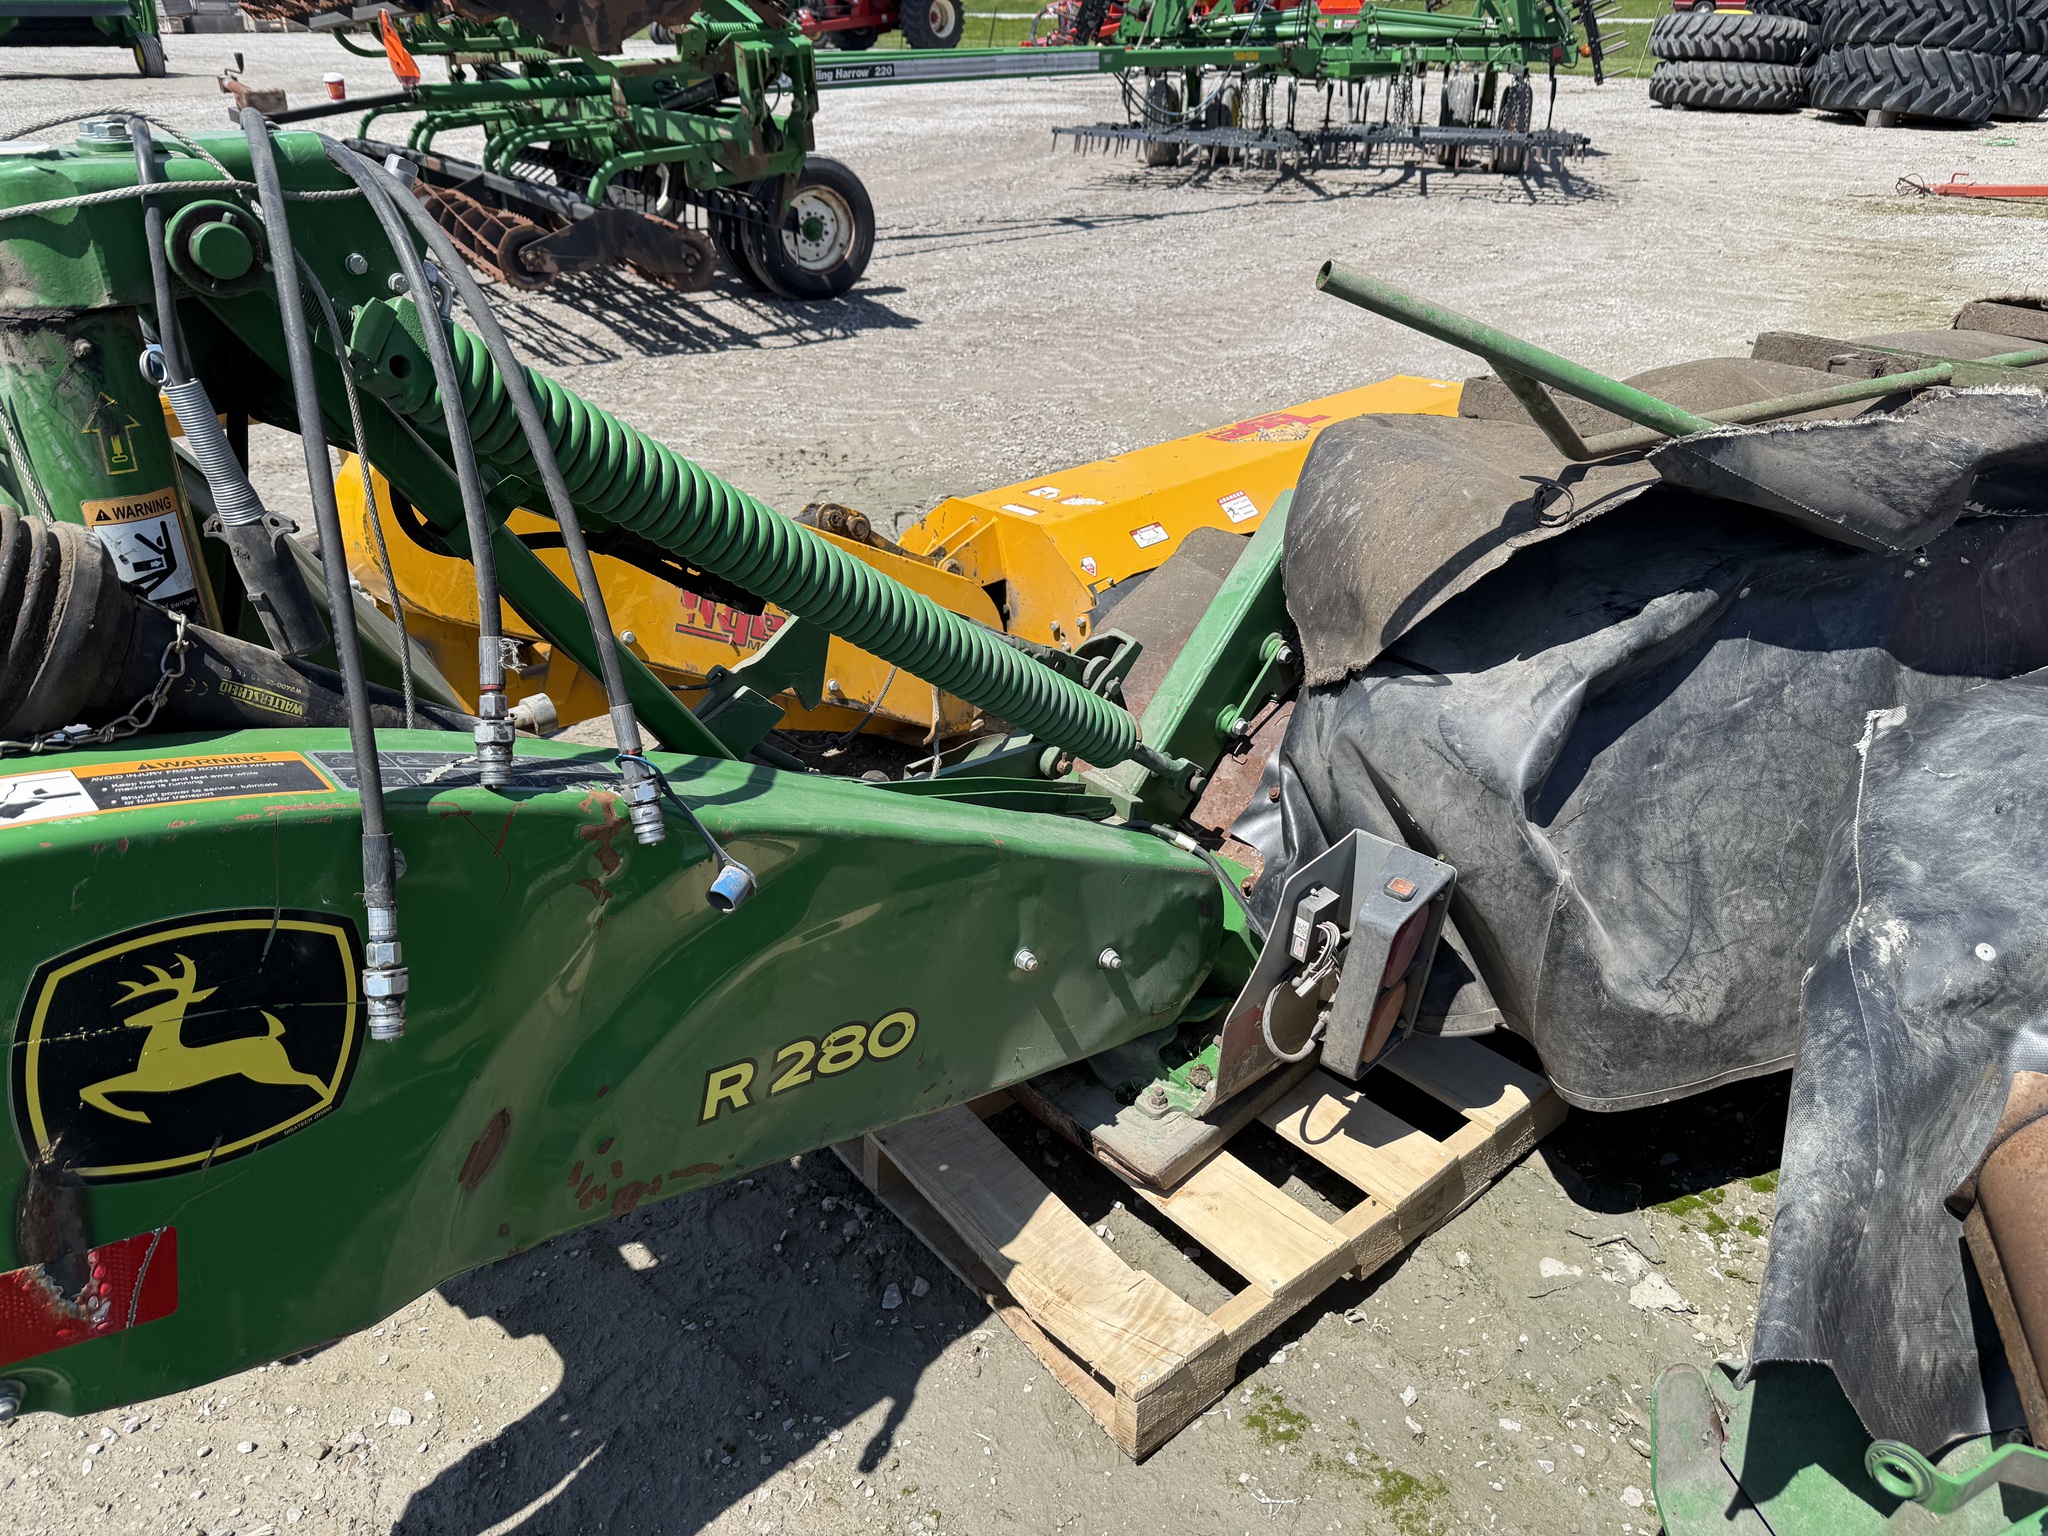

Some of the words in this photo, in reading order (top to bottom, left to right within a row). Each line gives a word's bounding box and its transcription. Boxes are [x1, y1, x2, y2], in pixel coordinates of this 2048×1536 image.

[815, 69, 834, 82] ling
[835, 68, 870, 80] Harrow
[874, 65, 893, 77] 220
[112, 496, 172, 521] WARNING
[170, 595, 198, 608] swinging
[219, 681, 303, 716] WALTERSCHEID
[157, 755, 267, 768] WARNING
[91, 774, 123, 782] AVOID
[126, 770, 163, 778] INJURY
[198, 763, 248, 771] ROTATING
[114, 784, 156, 793] machine
[168, 779, 204, 788] running
[172, 792, 214, 801] transport
[699, 1059, 757, 1124] R
[768, 1009, 918, 1096] 280
